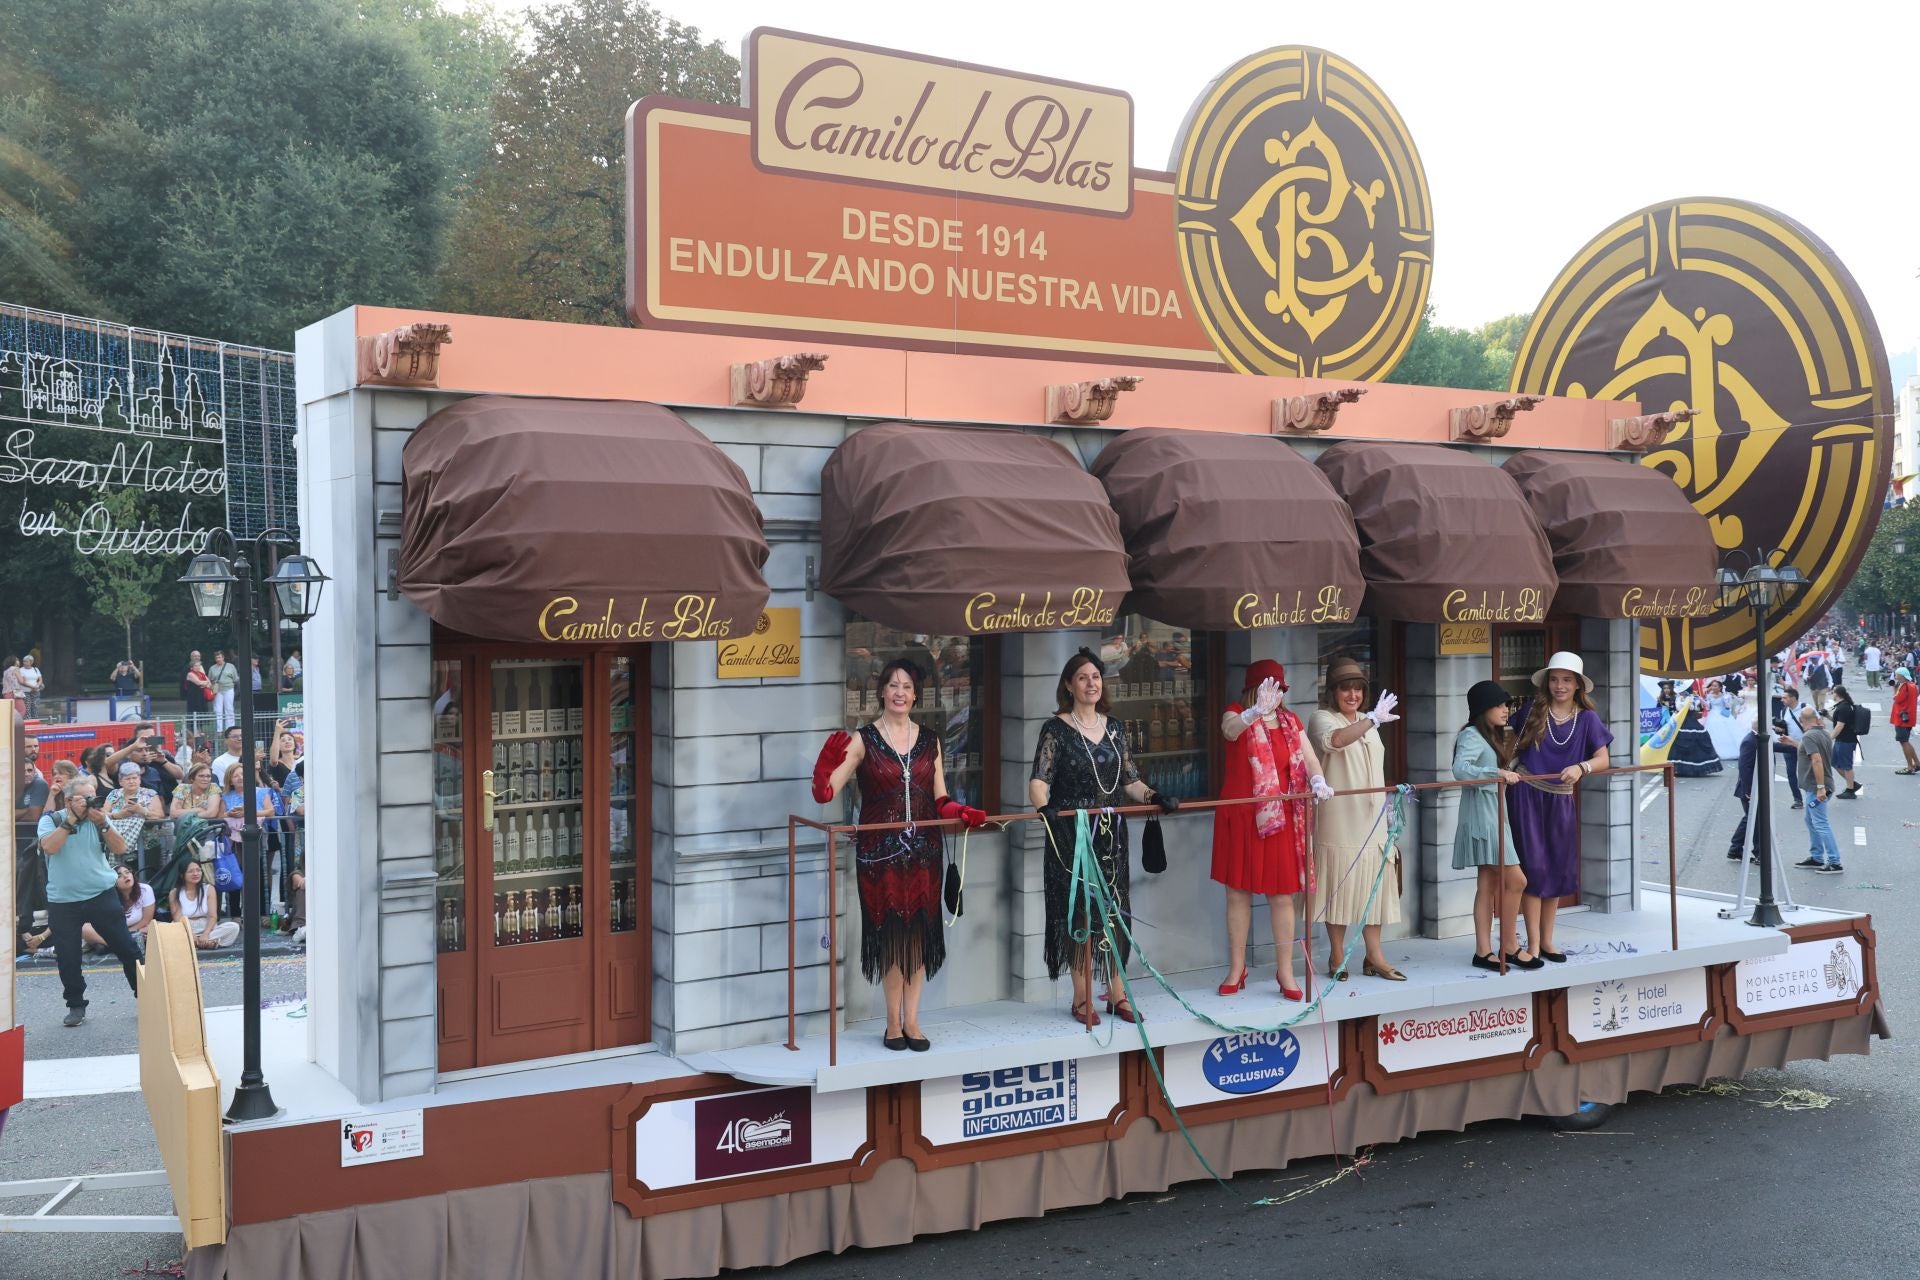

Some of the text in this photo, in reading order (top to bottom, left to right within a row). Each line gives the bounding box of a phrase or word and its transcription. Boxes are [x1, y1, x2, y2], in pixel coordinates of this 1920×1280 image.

[774, 57, 1113, 192] Camilo de Blas
[842, 207, 1048, 261] DESDE 1914
[669, 237, 1183, 319] ENDULZANDO NUESTRA VIDA
[0, 429, 227, 494] San Mateo
[76, 502, 209, 555] Oviedo
[538, 594, 733, 641] Camilo de Blas
[965, 586, 1114, 632] Camilo de Blas
[1233, 593, 1288, 630] Camilo
[1290, 591, 1306, 623] de
[1442, 587, 1544, 622] Camilo de Bla
[1621, 587, 1662, 618] Camilo
[1663, 589, 1677, 616] de
[1441, 628, 1463, 645] Camilo
[717, 643, 800, 667] Camilo de Blas
[1637, 983, 1667, 1001] Hotel
[1746, 968, 1818, 988] MONASTERIO
[1746, 981, 1819, 1003] DE CORIAS
[1240, 1052, 1263, 1064] S.L.
[1219, 1067, 1284, 1085] EXCLUSIVAS
[962, 1081, 1064, 1116] global
[966, 1106, 1063, 1135] INFORMATICA
[745, 1134, 792, 1150] asemposil
